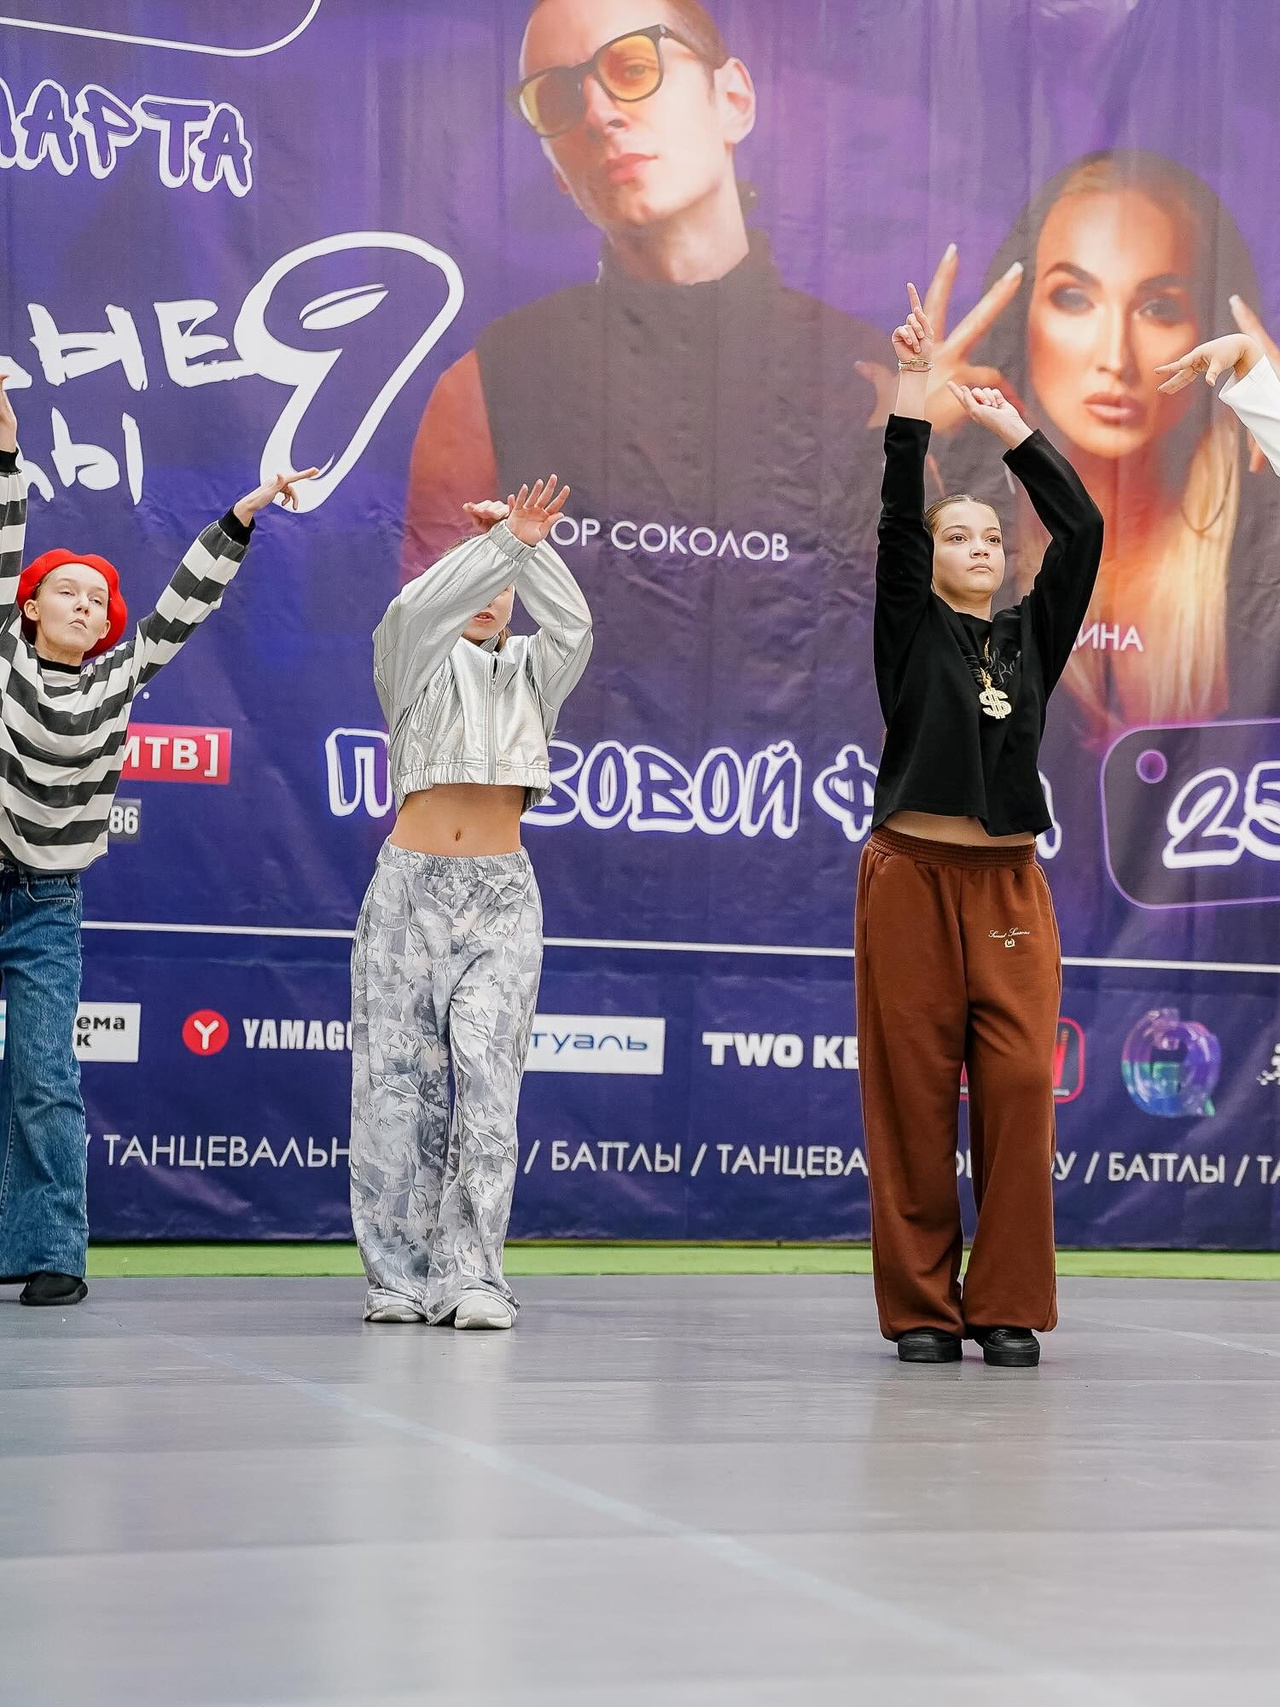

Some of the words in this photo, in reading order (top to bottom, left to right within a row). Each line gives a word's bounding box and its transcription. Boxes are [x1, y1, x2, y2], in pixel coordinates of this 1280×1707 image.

[551, 516, 601, 547] ОР
[611, 520, 790, 562] СОКОЛОВ
[1073, 621, 1144, 652] ИНА
[325, 727, 801, 840] ПЗОВОЙ
[109, 805, 139, 835] 86
[76, 1016, 125, 1030] ема
[531, 1032, 648, 1055] туаль
[702, 1031, 803, 1068] TWO
[812, 1035, 859, 1069] KE
[103, 1135, 351, 1170] ТАНЦЕВАЛЬН
[551, 1140, 681, 1173] БАТТЛЫ
[716, 1143, 869, 1178] ТАНЦЕВА
[1108, 1152, 1226, 1183] БАТТЛЫ
